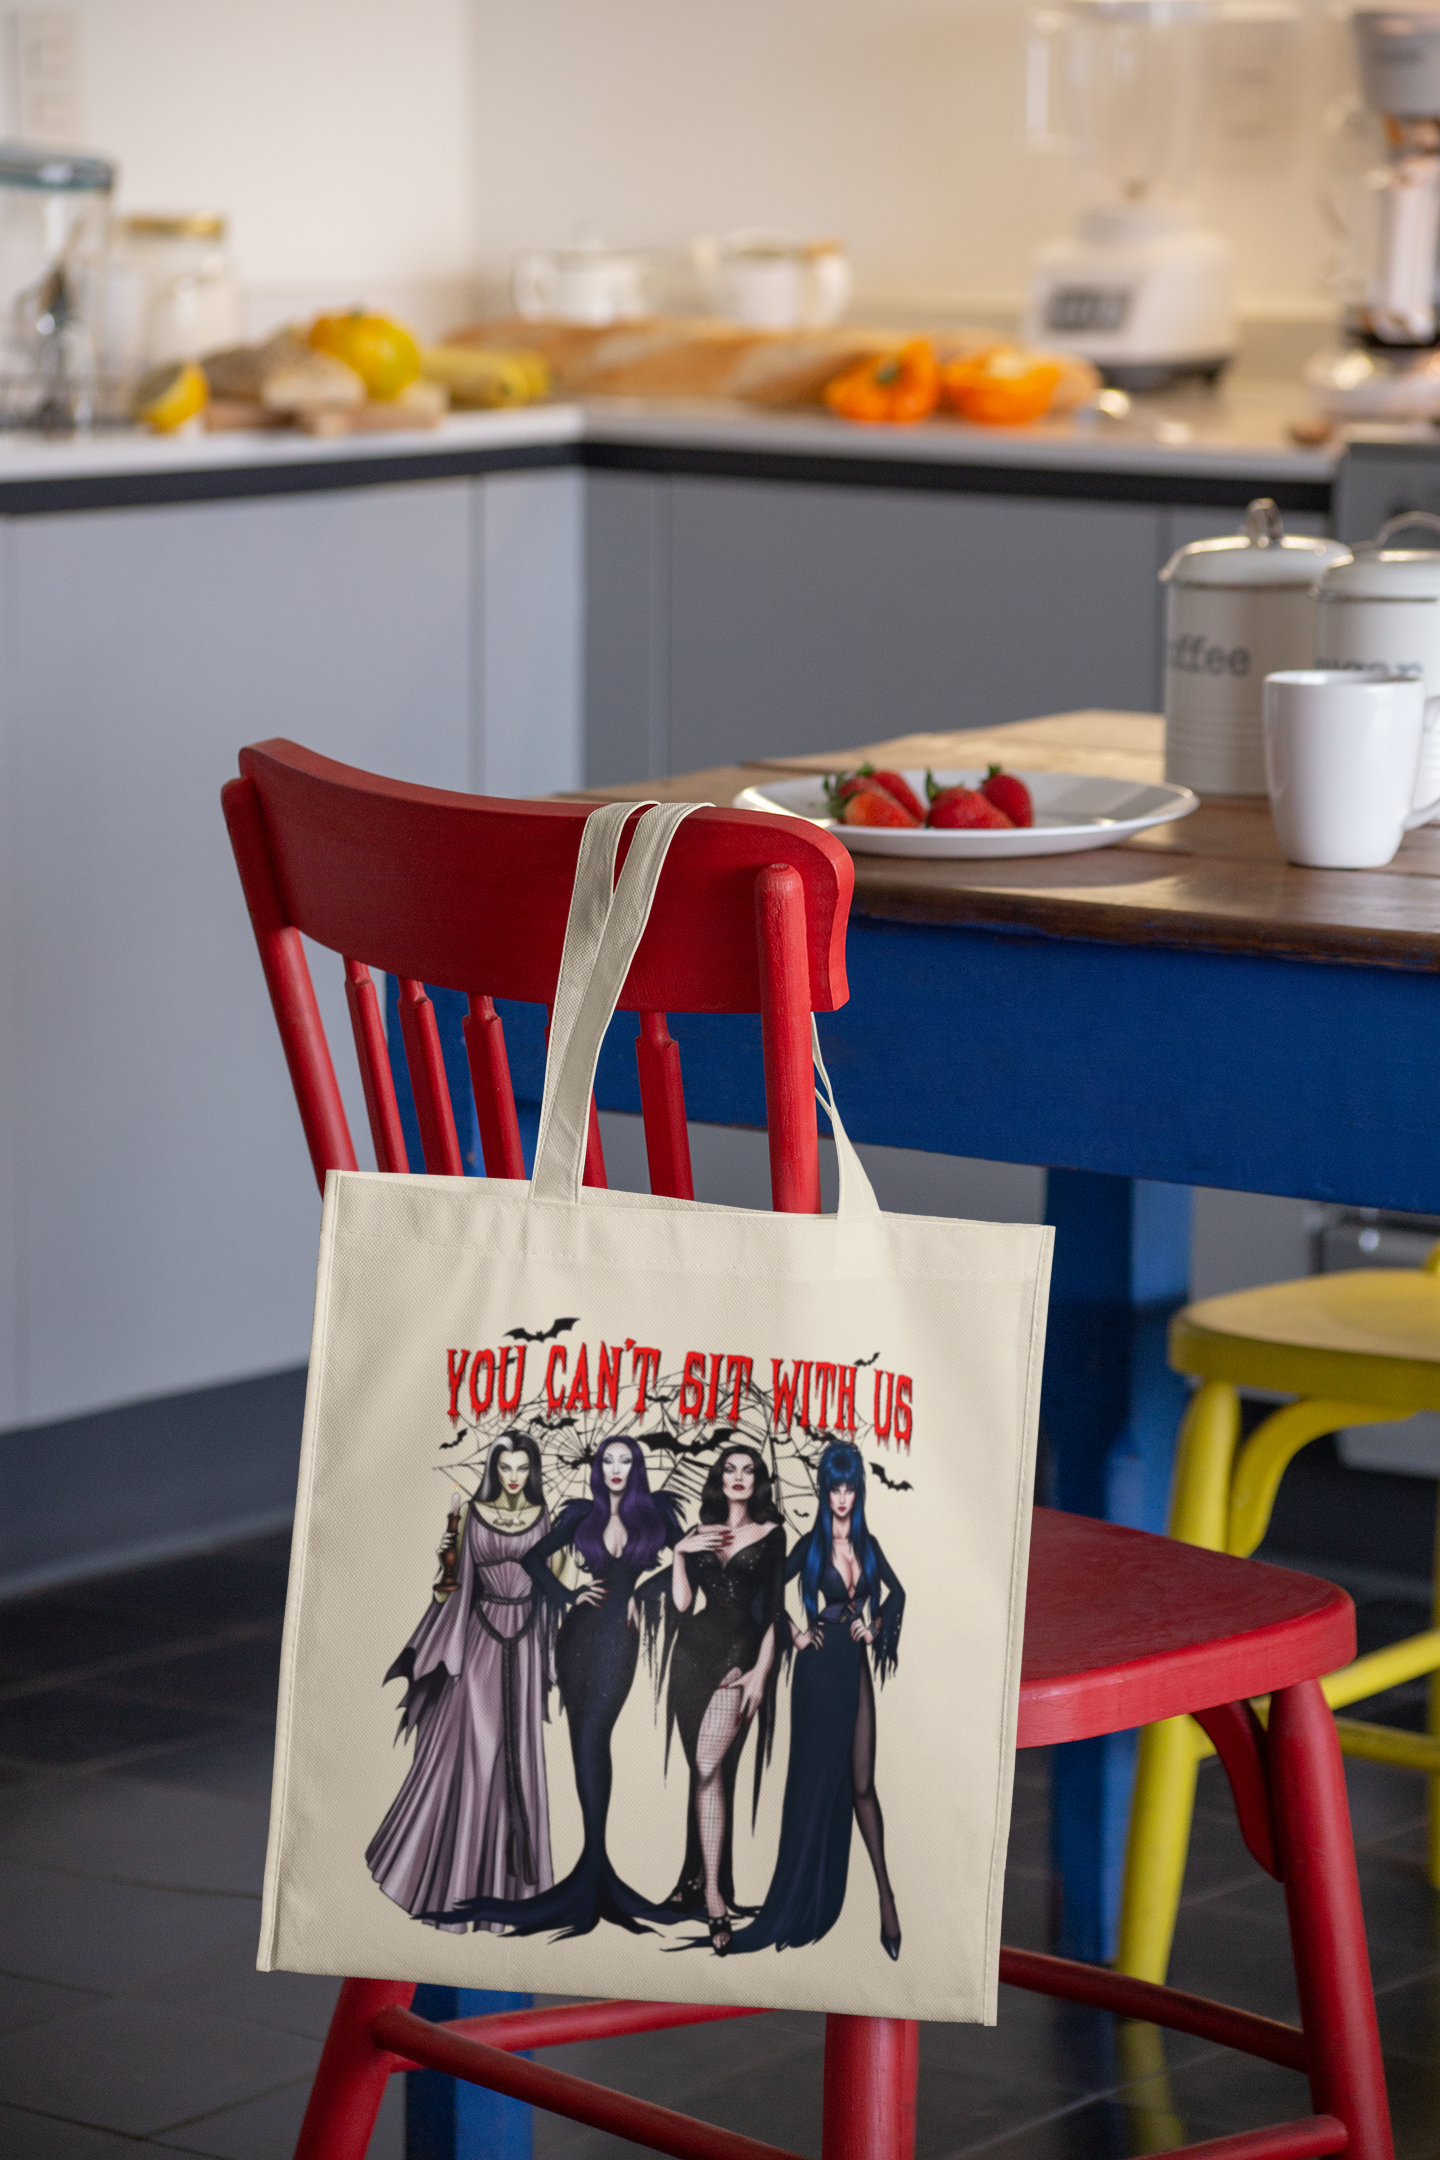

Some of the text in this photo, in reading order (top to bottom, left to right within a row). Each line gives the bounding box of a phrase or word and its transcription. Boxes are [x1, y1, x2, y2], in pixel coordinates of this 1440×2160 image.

[1168, 633, 1251, 677] ffee
[446, 1338, 913, 1451] YOU CAN'T SIT WITH US
